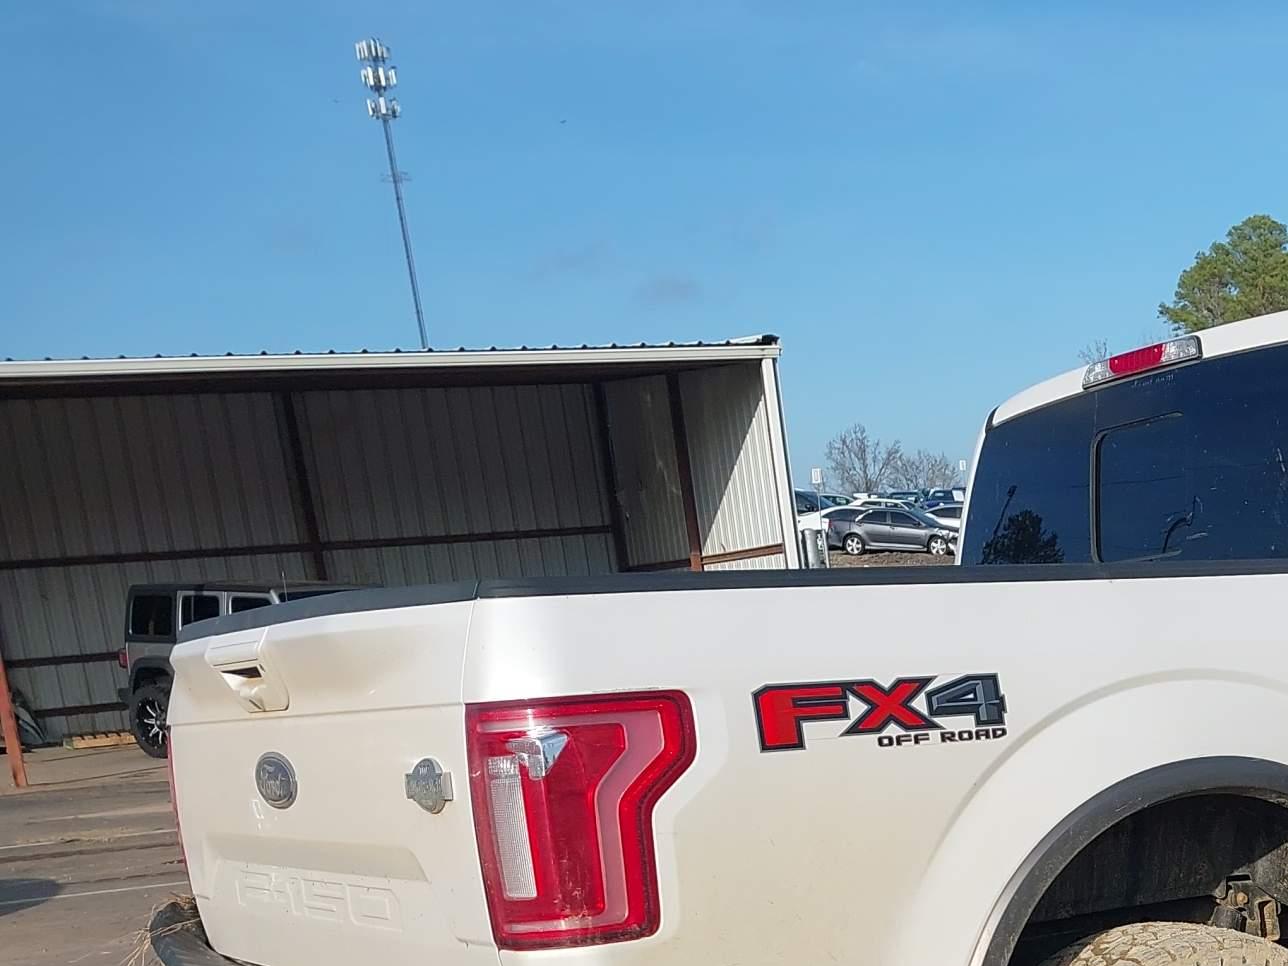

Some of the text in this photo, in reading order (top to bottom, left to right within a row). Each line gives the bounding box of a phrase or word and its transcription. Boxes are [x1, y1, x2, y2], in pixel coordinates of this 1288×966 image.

[751, 672, 1007, 753] FX4
[877, 727, 1008, 748] OFF ROAD
